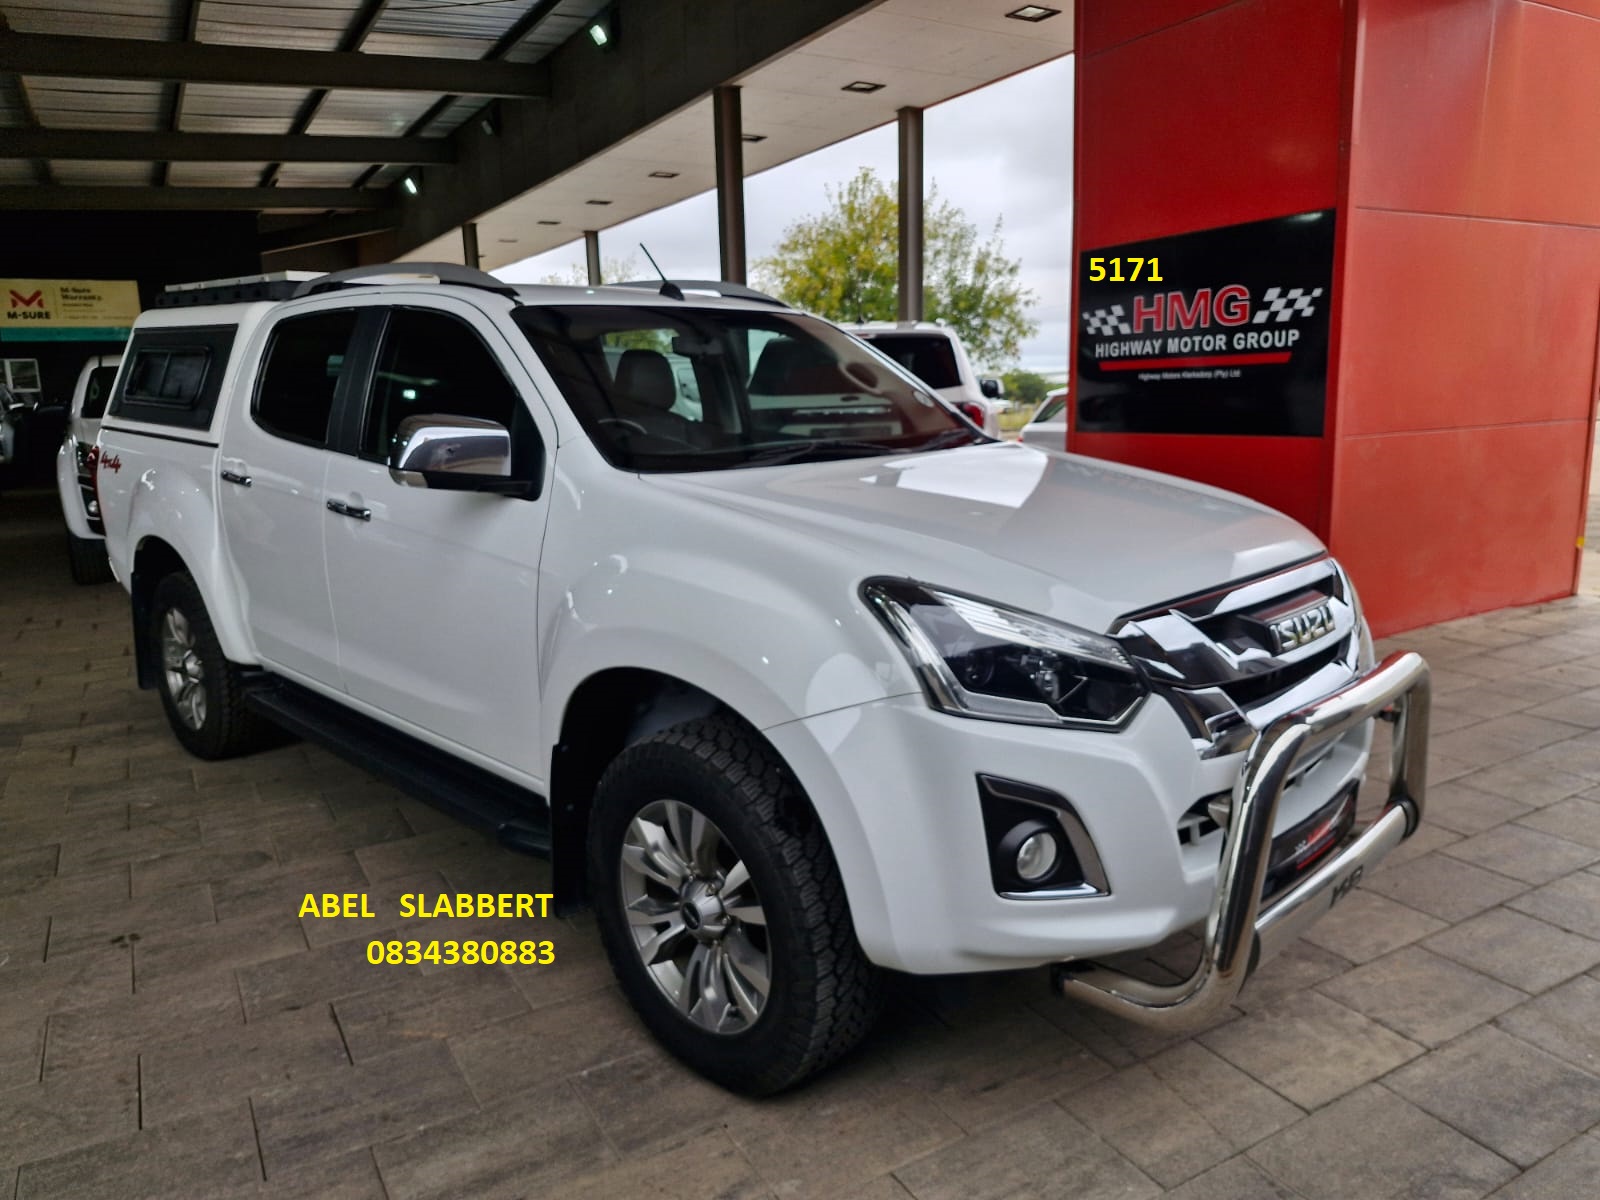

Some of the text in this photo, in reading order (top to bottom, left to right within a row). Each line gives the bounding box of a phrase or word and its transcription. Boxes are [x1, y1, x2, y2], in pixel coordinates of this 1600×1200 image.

[7, 311, 51, 320] M-SURE
[1132, 284, 1251, 334] HMG
[1095, 329, 1300, 358] HIGHWAY MOTOR GROUP
[1269, 603, 1338, 653] ISUZU
